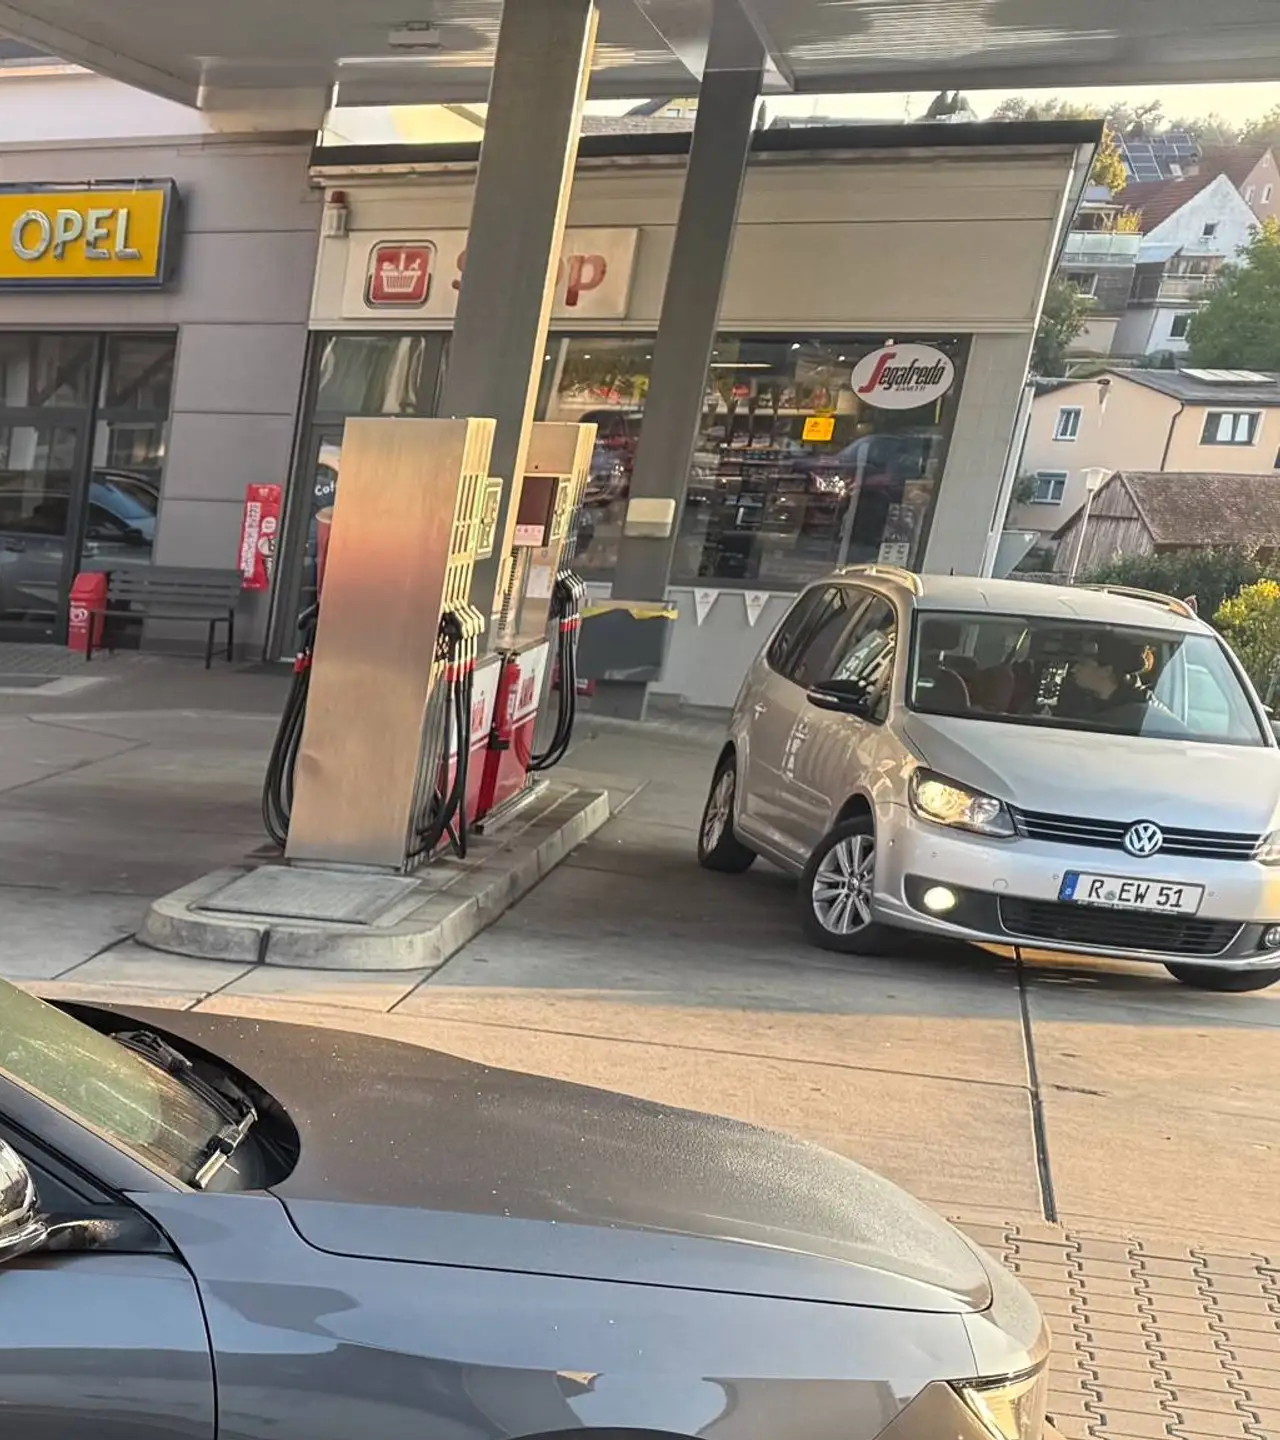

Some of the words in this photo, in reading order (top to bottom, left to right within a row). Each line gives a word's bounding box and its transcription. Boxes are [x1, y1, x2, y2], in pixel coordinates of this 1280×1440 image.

[11, 208, 142, 261] OPEL
[858, 352, 947, 394] Segafredo
[1088, 879, 1104, 899] R
[1118, 882, 1150, 904] EW
[1156, 886, 1184, 908] 51
